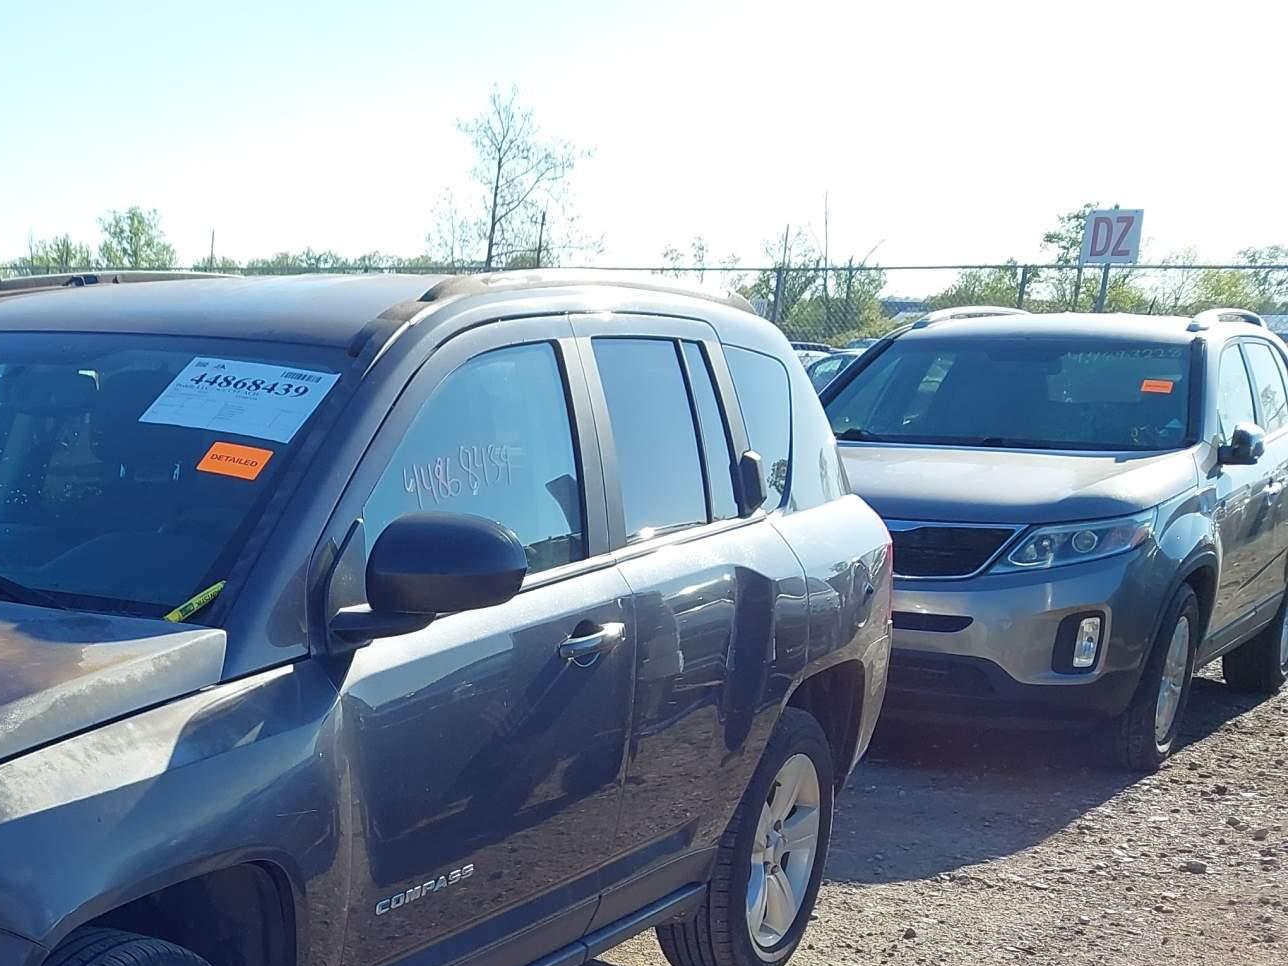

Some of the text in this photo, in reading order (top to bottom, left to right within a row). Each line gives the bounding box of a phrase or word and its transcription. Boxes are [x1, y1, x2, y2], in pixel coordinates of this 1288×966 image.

[1089, 215, 1135, 257] DZ
[190, 372, 309, 398] 44868439
[210, 453, 258, 468] DETAILED
[375, 863, 474, 915] COMPASS
